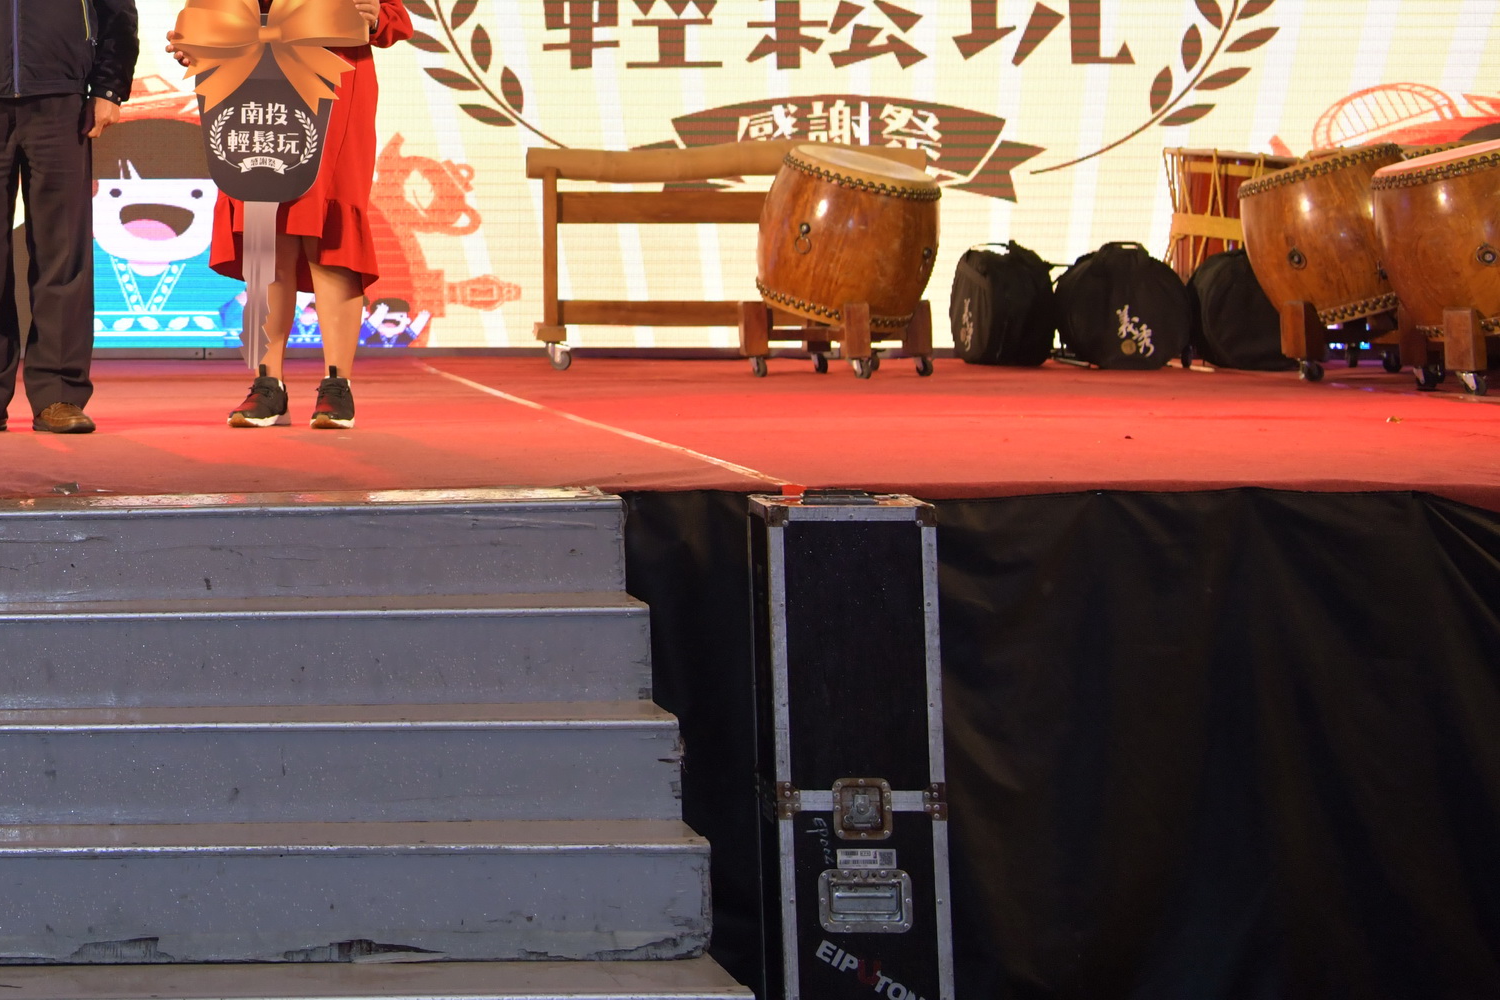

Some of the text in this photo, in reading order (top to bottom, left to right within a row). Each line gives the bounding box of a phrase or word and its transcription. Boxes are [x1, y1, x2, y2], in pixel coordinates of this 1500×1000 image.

[241, 101, 288, 126] 南投
[227, 129, 300, 155] 輕鬆玩
